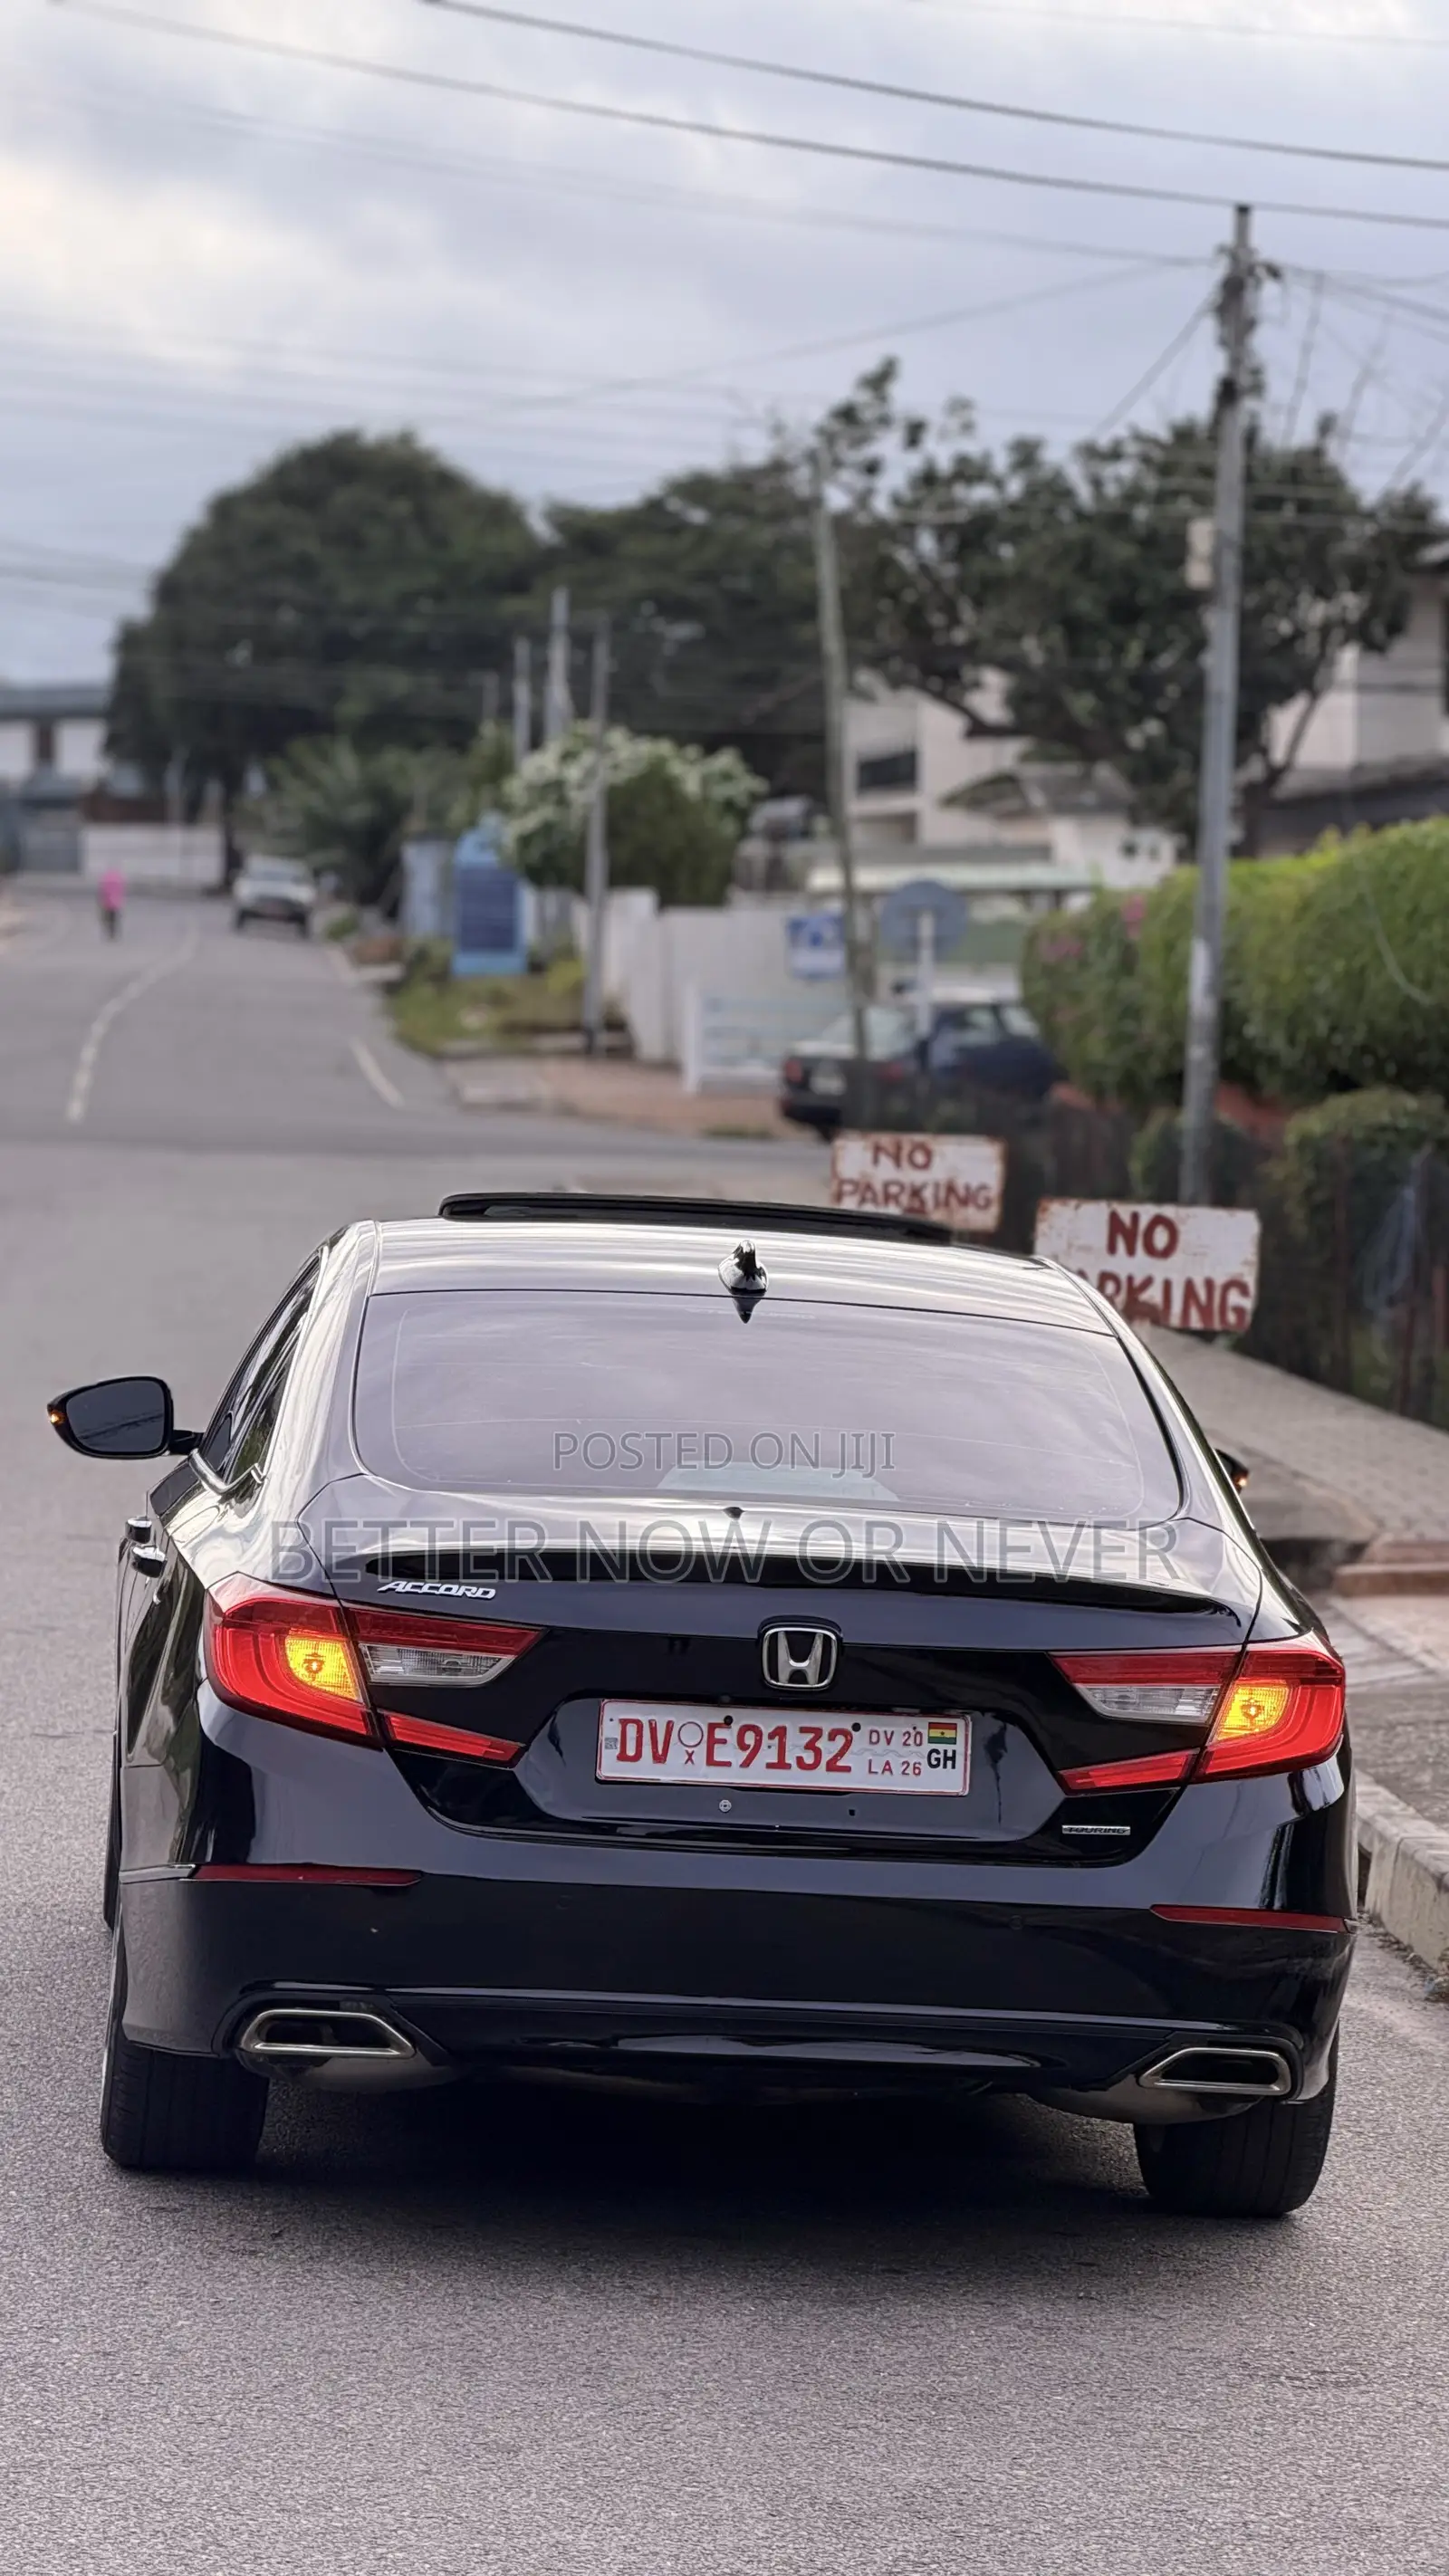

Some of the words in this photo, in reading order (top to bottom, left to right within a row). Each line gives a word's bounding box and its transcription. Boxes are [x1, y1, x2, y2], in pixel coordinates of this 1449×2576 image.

[871, 1140, 935, 1172] NO
[832, 1177, 994, 1214] PARKING
[1107, 1209, 1179, 1259] NO
[1077, 1269, 1252, 1331] RKING
[377, 1579, 497, 1601] ACCORD
[616, 1718, 675, 1764] DV
[705, 1721, 853, 1773] E9132
[868, 1728, 895, 1747] DV
[901, 1729, 925, 1748] 20
[867, 1757, 895, 1776] LA
[900, 1759, 923, 1777] 26
[926, 1748, 957, 1771] GH
[1065, 1826, 1128, 1834] TOURING
